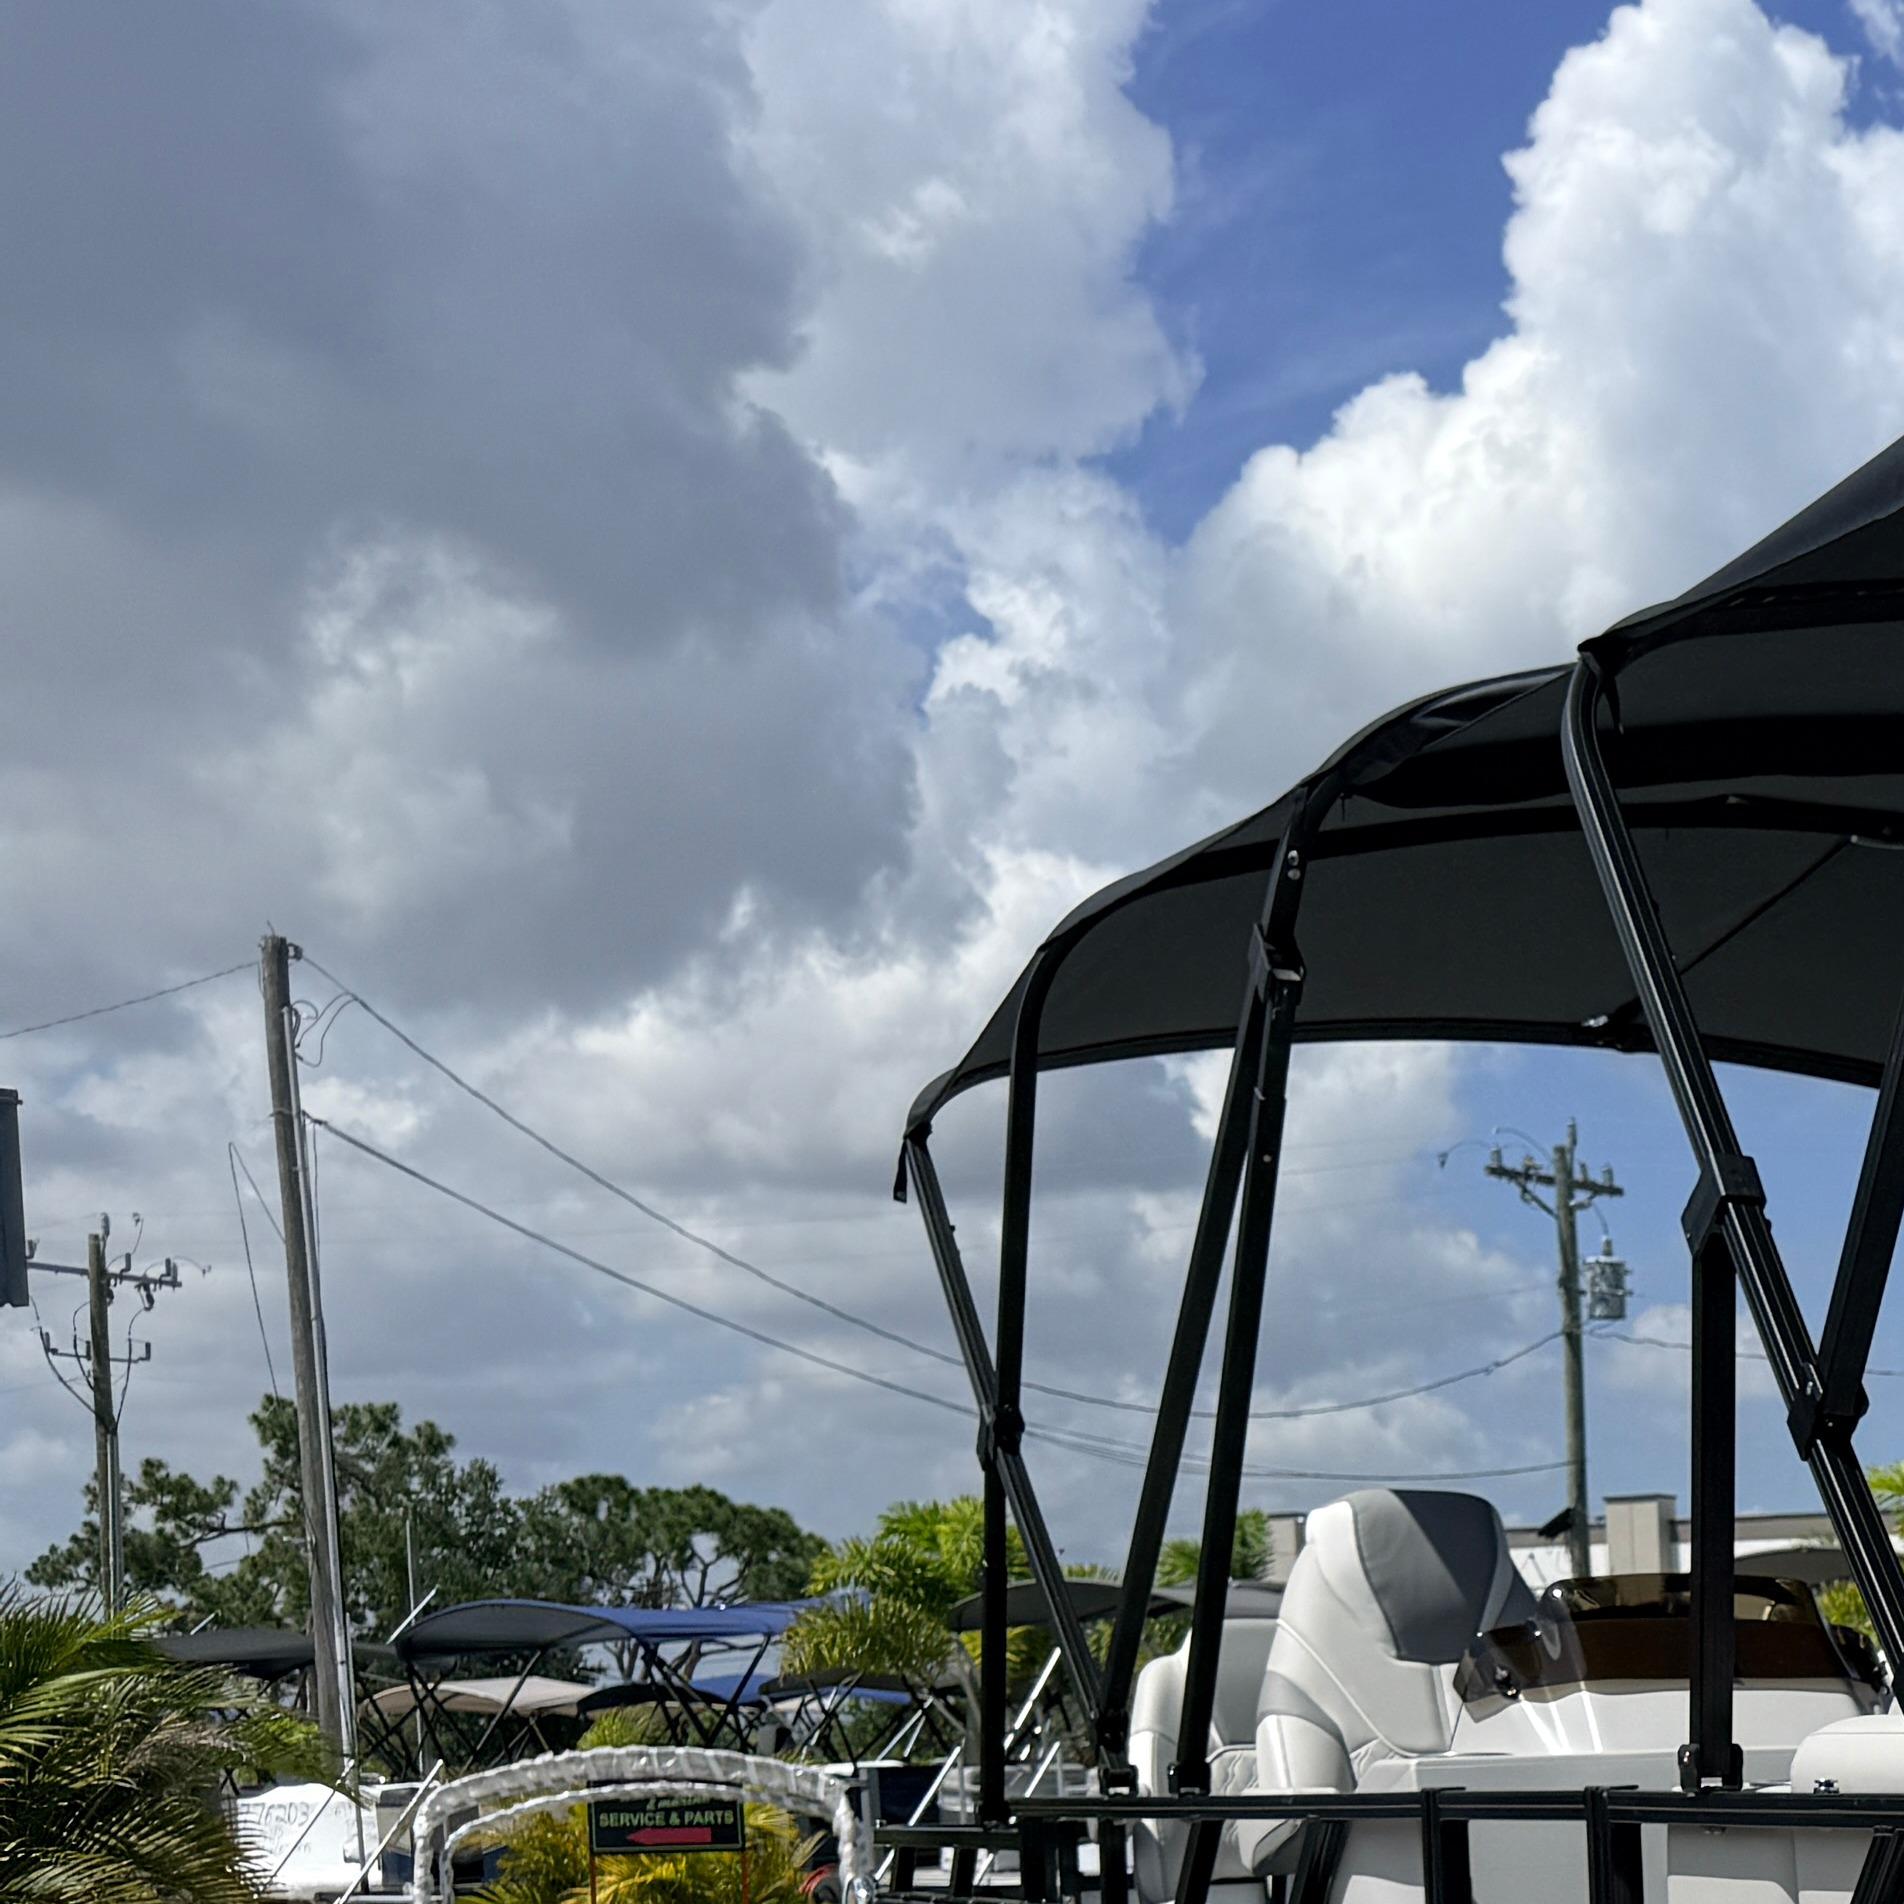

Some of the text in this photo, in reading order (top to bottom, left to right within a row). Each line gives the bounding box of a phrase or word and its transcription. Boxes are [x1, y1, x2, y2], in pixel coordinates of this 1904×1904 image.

[600, 1810, 734, 1828] SERVICE & PARTS
